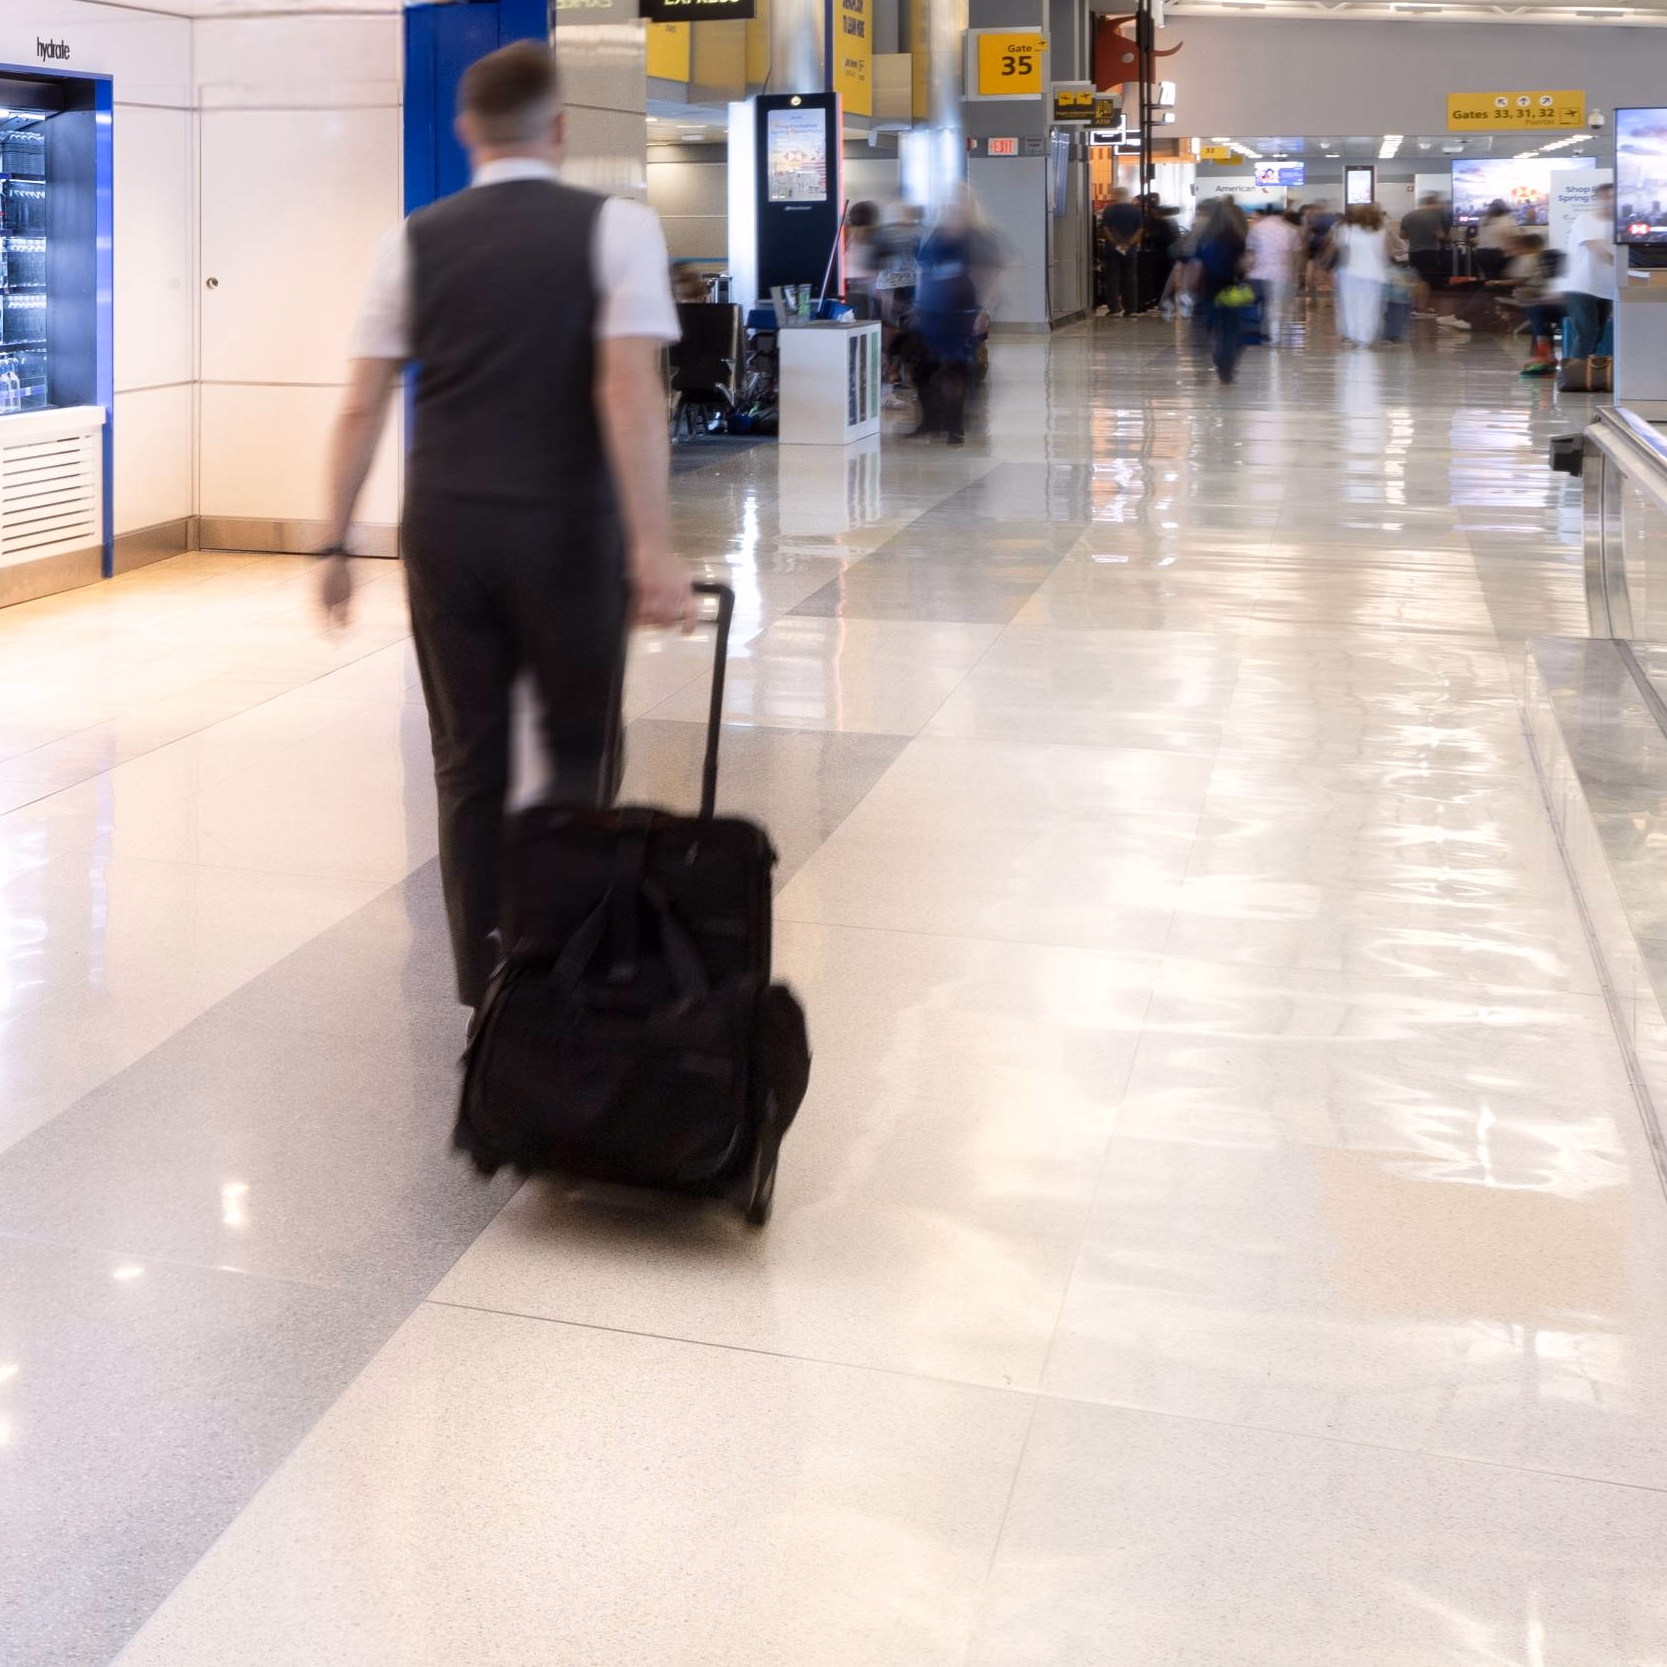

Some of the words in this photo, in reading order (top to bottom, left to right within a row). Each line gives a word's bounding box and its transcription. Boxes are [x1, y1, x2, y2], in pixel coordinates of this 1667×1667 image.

[36, 36, 70, 62] hydrate
[1008, 44, 1032, 53] Gate
[1001, 56, 1033, 76] 35
[1452, 110, 1488, 120] Gates
[1494, 110, 1513, 120] 33,
[1517, 109, 1536, 119] 31,
[1539, 108, 1554, 118] 32
[994, 140, 1014, 154] EXIT
[1215, 185, 1255, 193] American
[1566, 186, 1590, 194] Shop
[1558, 195, 1588, 203] Spring
